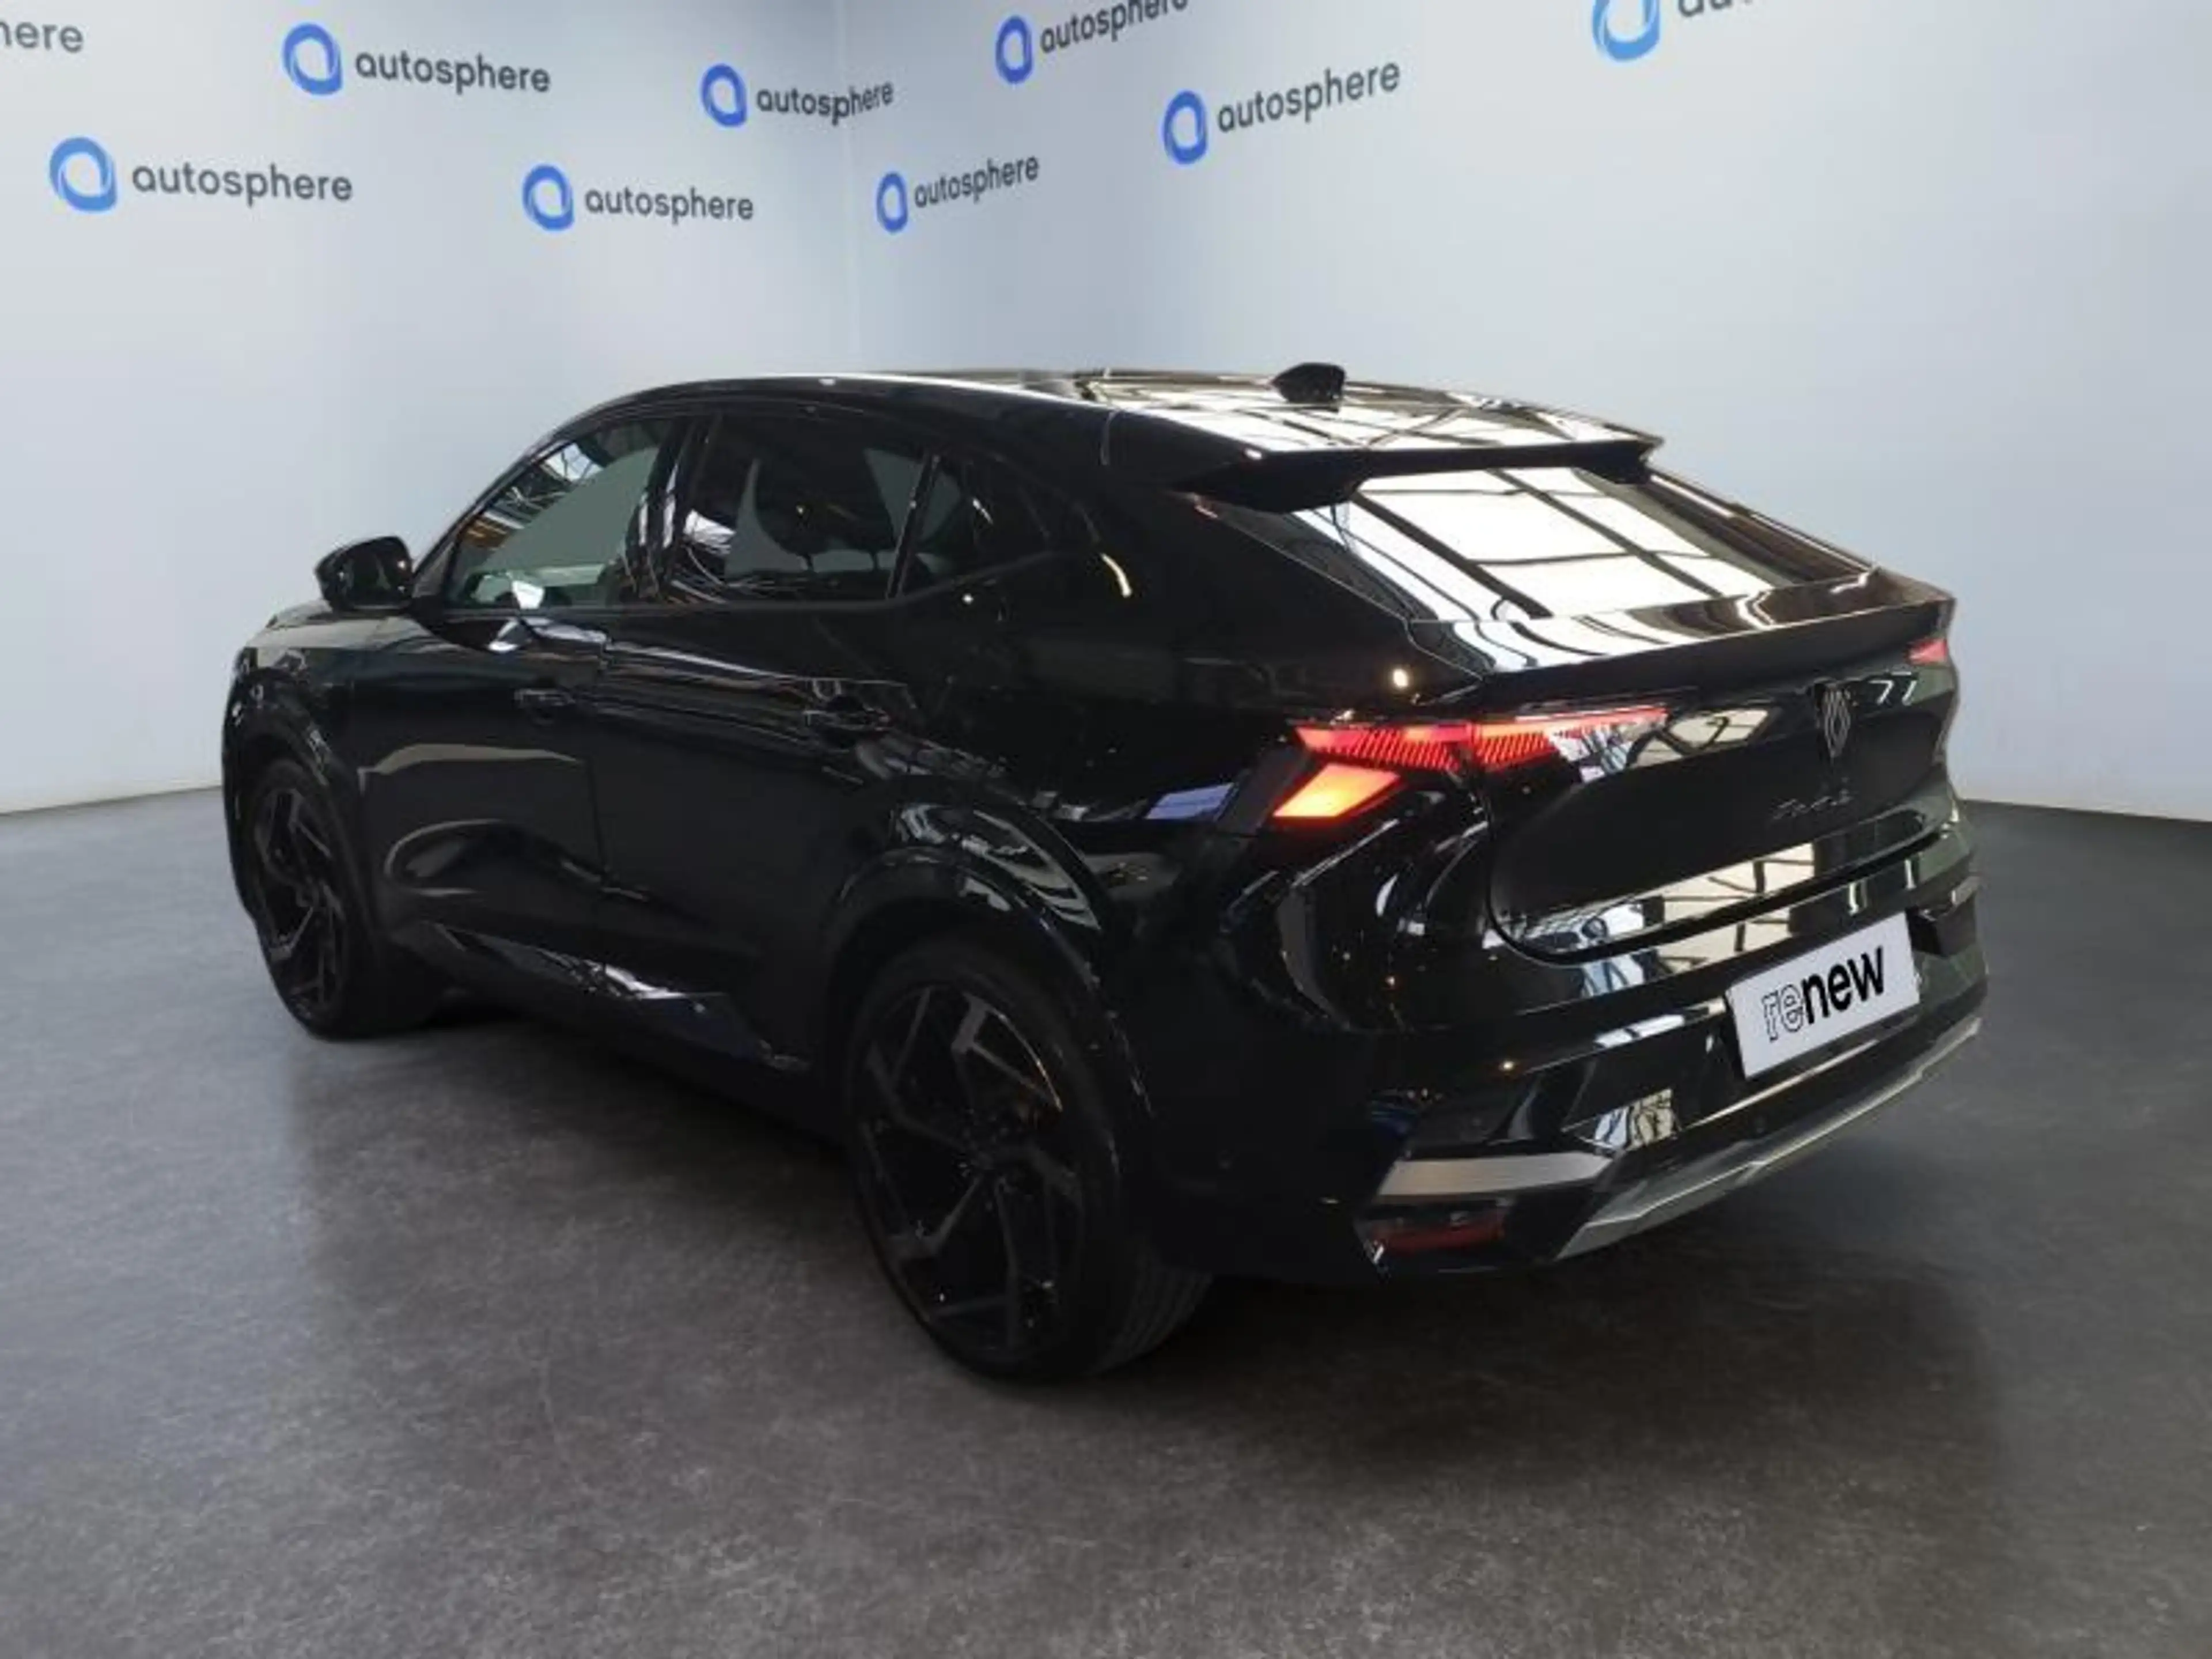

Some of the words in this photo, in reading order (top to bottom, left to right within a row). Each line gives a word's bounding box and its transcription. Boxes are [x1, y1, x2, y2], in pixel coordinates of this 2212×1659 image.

[355, 50, 551, 95] autosphere
[756, 81, 894, 126] autosphere
[1217, 61, 1400, 132] autosphere
[132, 162, 353, 207] autosphere
[914, 154, 1039, 207] autosphere
[585, 187, 753, 224] autosphere
[1760, 945, 1885, 1042] renew
